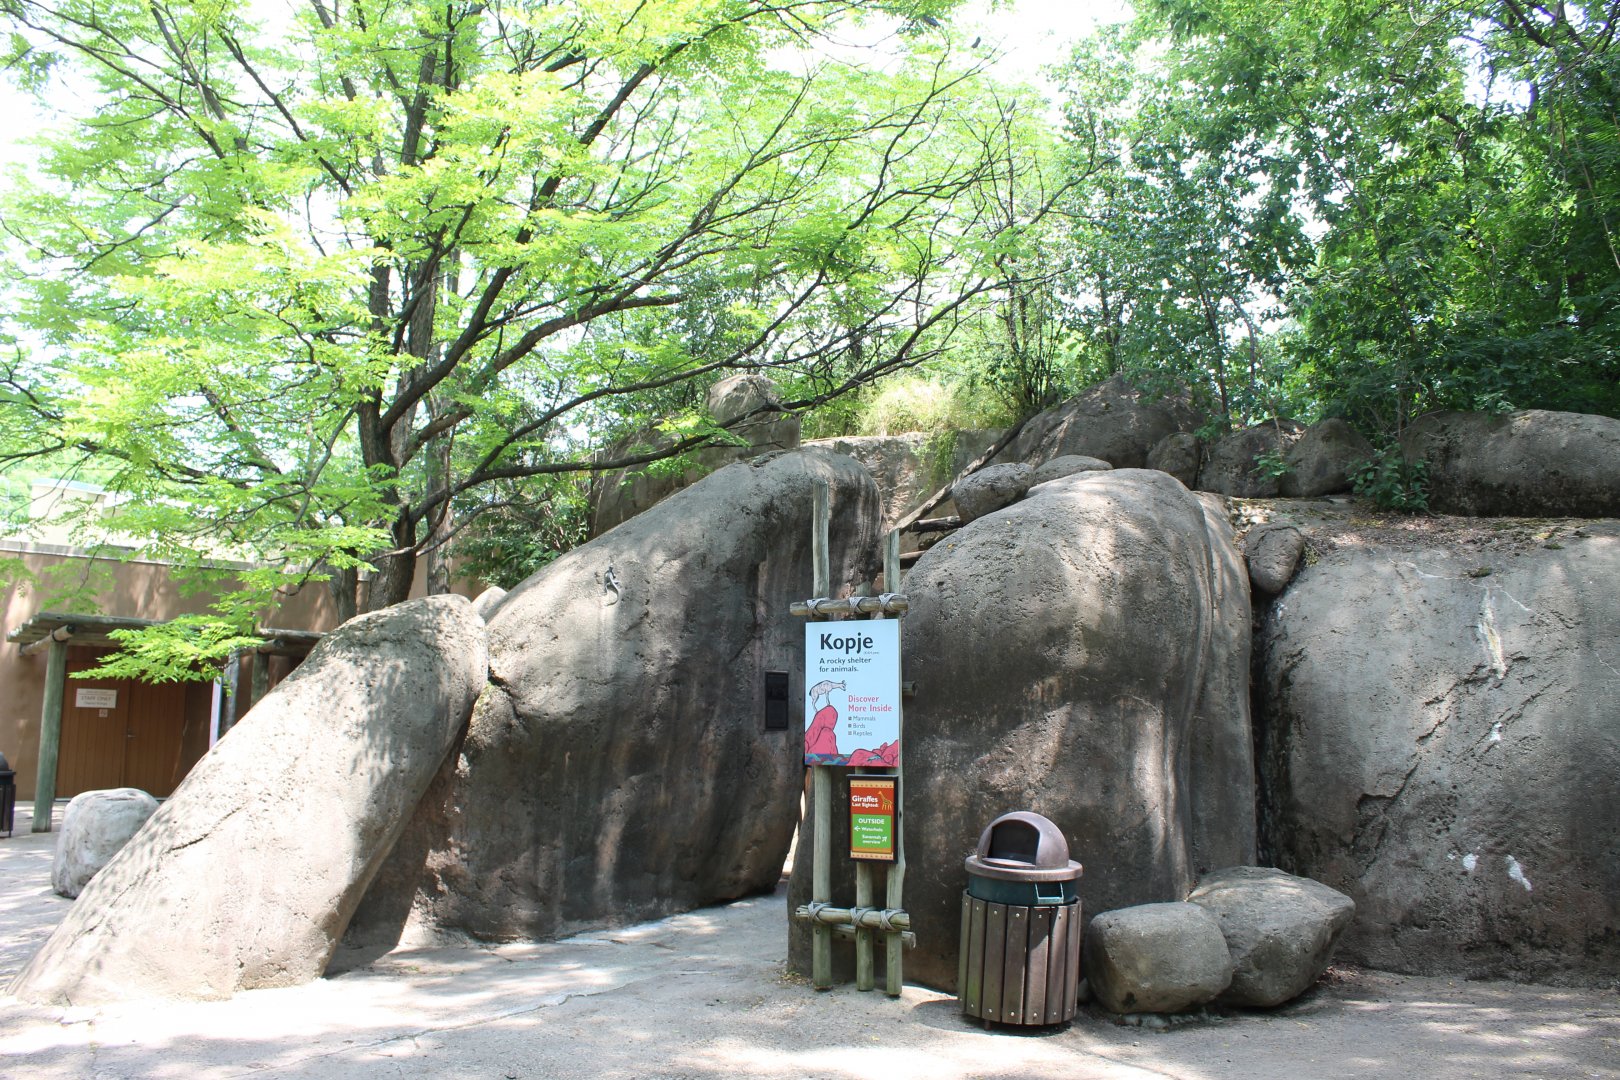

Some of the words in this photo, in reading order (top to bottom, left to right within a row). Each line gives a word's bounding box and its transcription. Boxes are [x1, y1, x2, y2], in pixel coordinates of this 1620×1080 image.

[820, 632, 874, 654] Kopje
[827, 657, 846, 665] rocky
[819, 665, 829, 673] for
[830, 665, 859, 673] animals.
[848, 695, 880, 703] Discover
[848, 704, 867, 712] More
[869, 704, 892, 712] Inside
